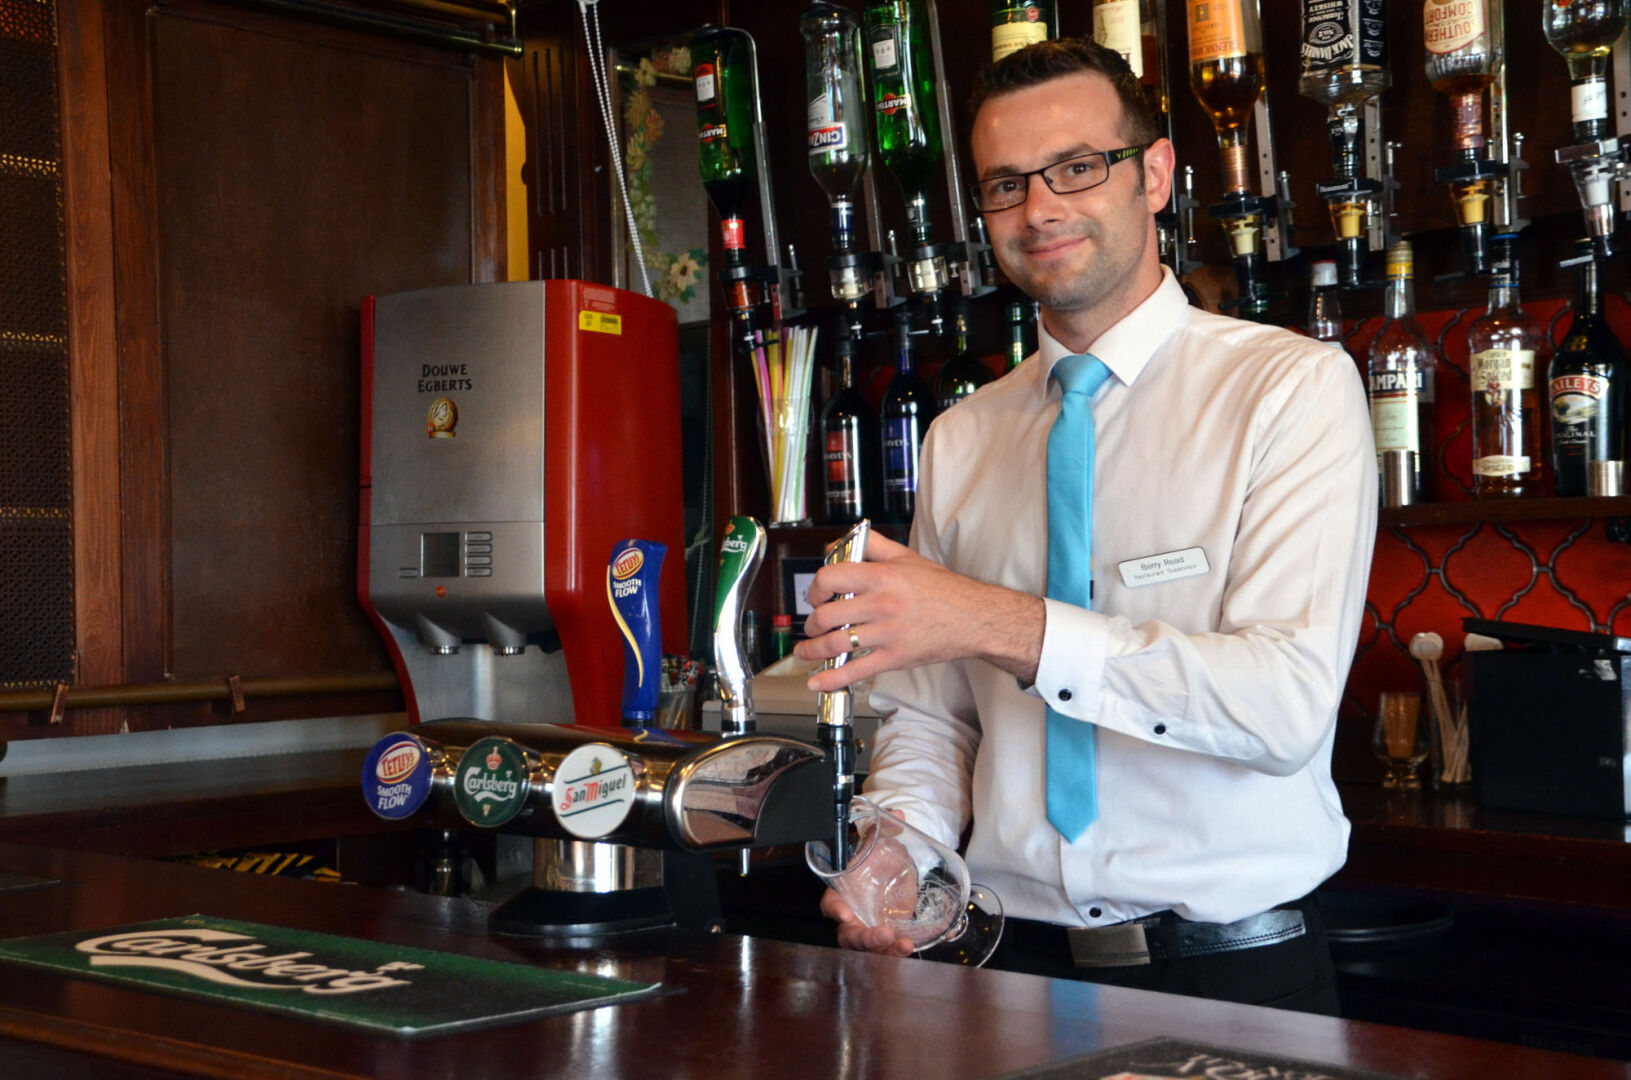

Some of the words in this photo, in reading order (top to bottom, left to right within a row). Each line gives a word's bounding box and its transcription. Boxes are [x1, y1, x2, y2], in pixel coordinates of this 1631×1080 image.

[1424, 20, 1473, 43] OUTHER
[1331, 34, 1354, 56] JACK
[808, 130, 840, 147] CINZ
[422, 363, 468, 378] DOUWE
[417, 378, 473, 393] EGBERTS
[1368, 372, 1423, 391] AMPAI
[1551, 377, 1601, 395] AILEYS
[1140, 562, 1161, 571] Barry
[613, 578, 642, 589] SMOOTH
[615, 585, 638, 598] FLOW
[377, 783, 413, 798] SMOOTH
[464, 765, 518, 802] Carlsberg
[377, 794, 408, 810] FLOW
[74, 928, 417, 994] Carlsberg
